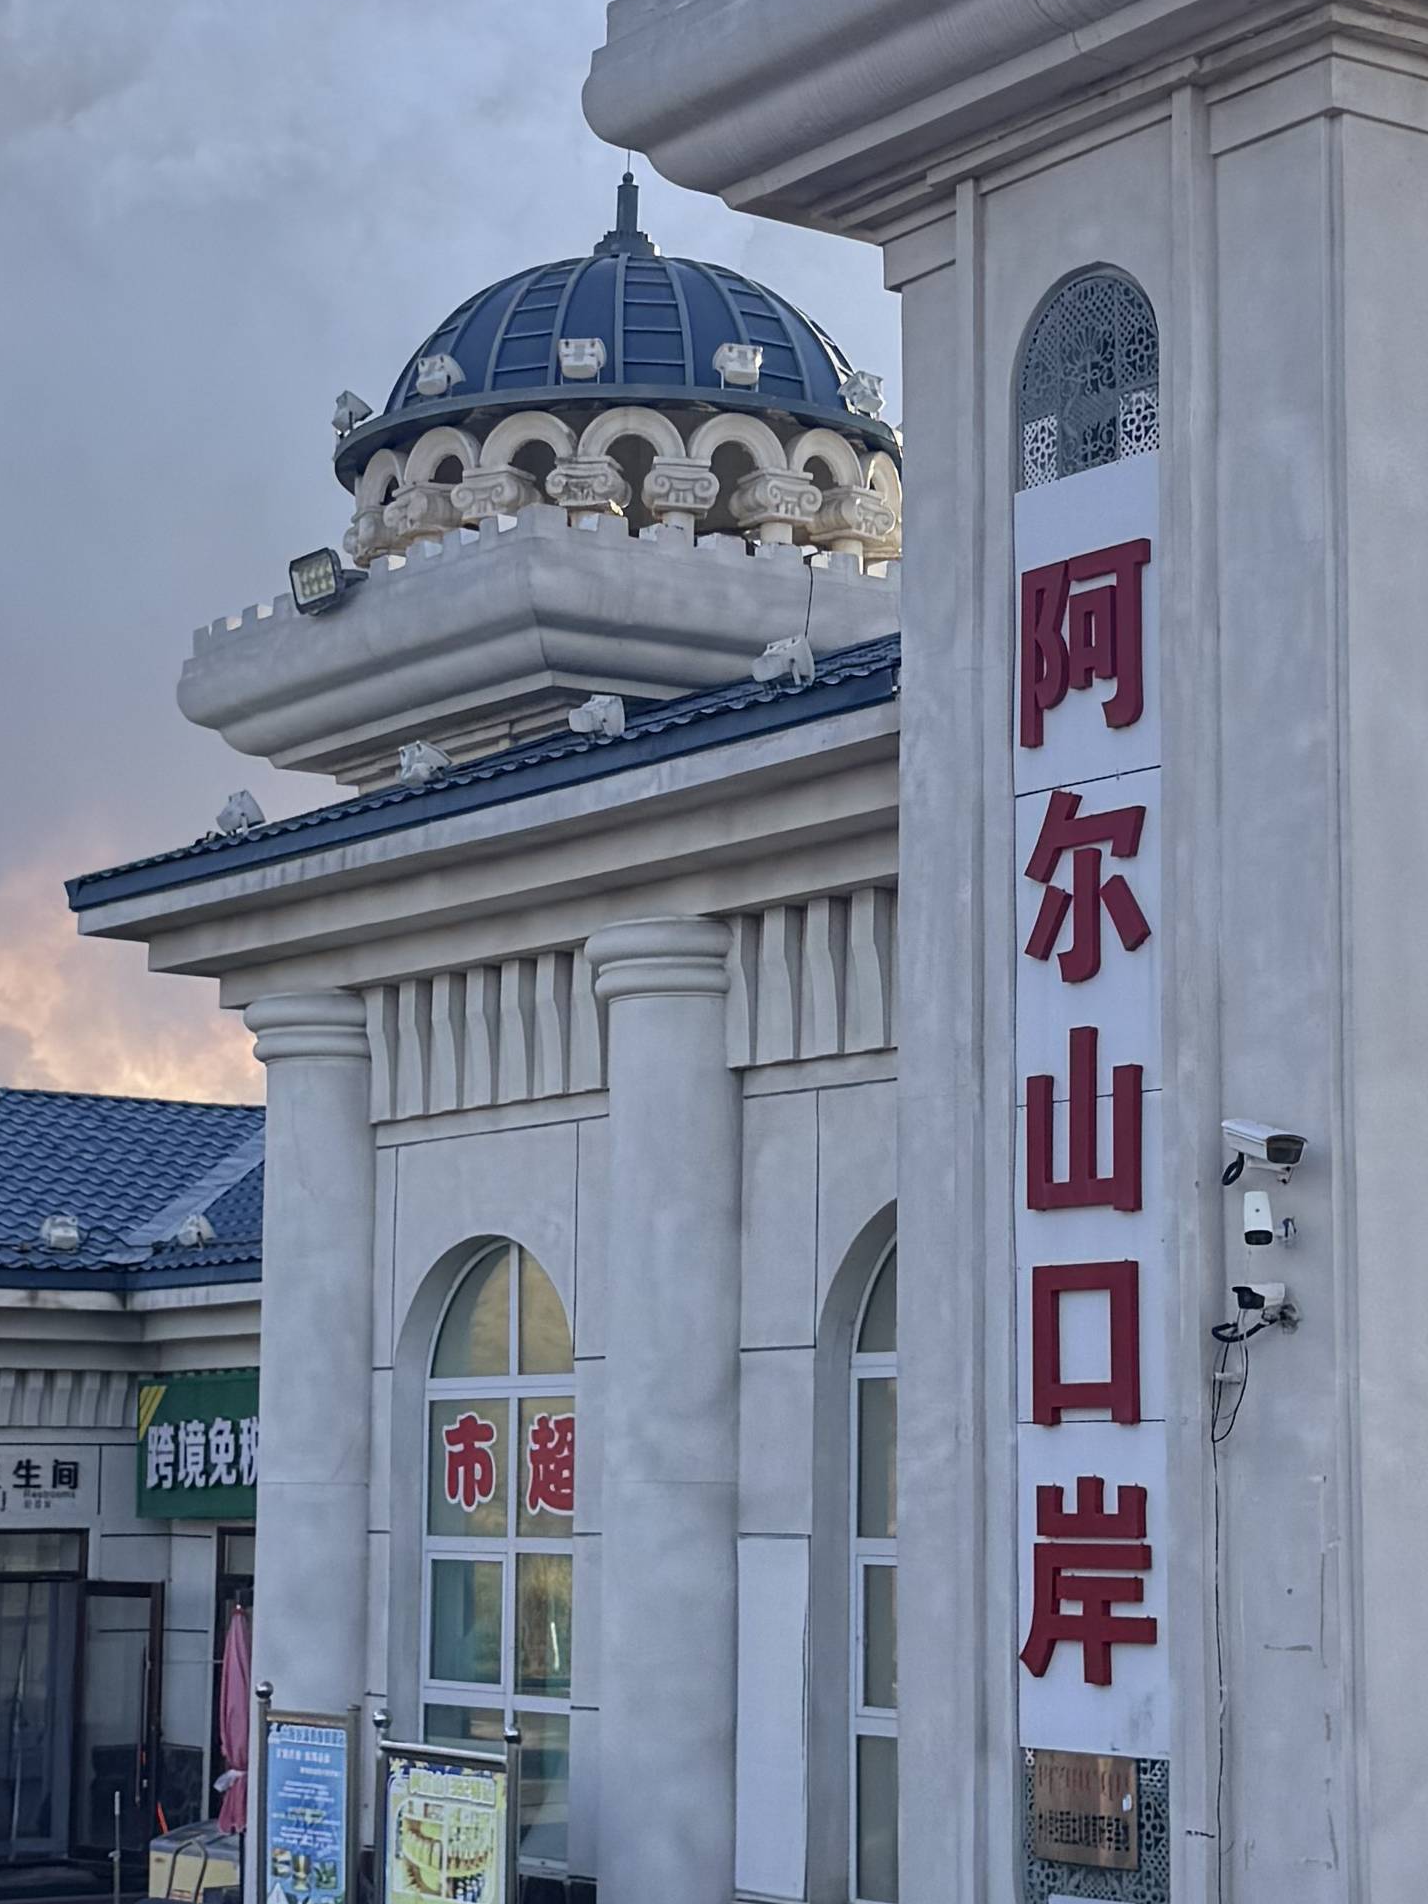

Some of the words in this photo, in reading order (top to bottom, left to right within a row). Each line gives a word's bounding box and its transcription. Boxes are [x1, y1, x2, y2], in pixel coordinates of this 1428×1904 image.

[1019, 538, 1157, 1686] 阿尔山口岸
